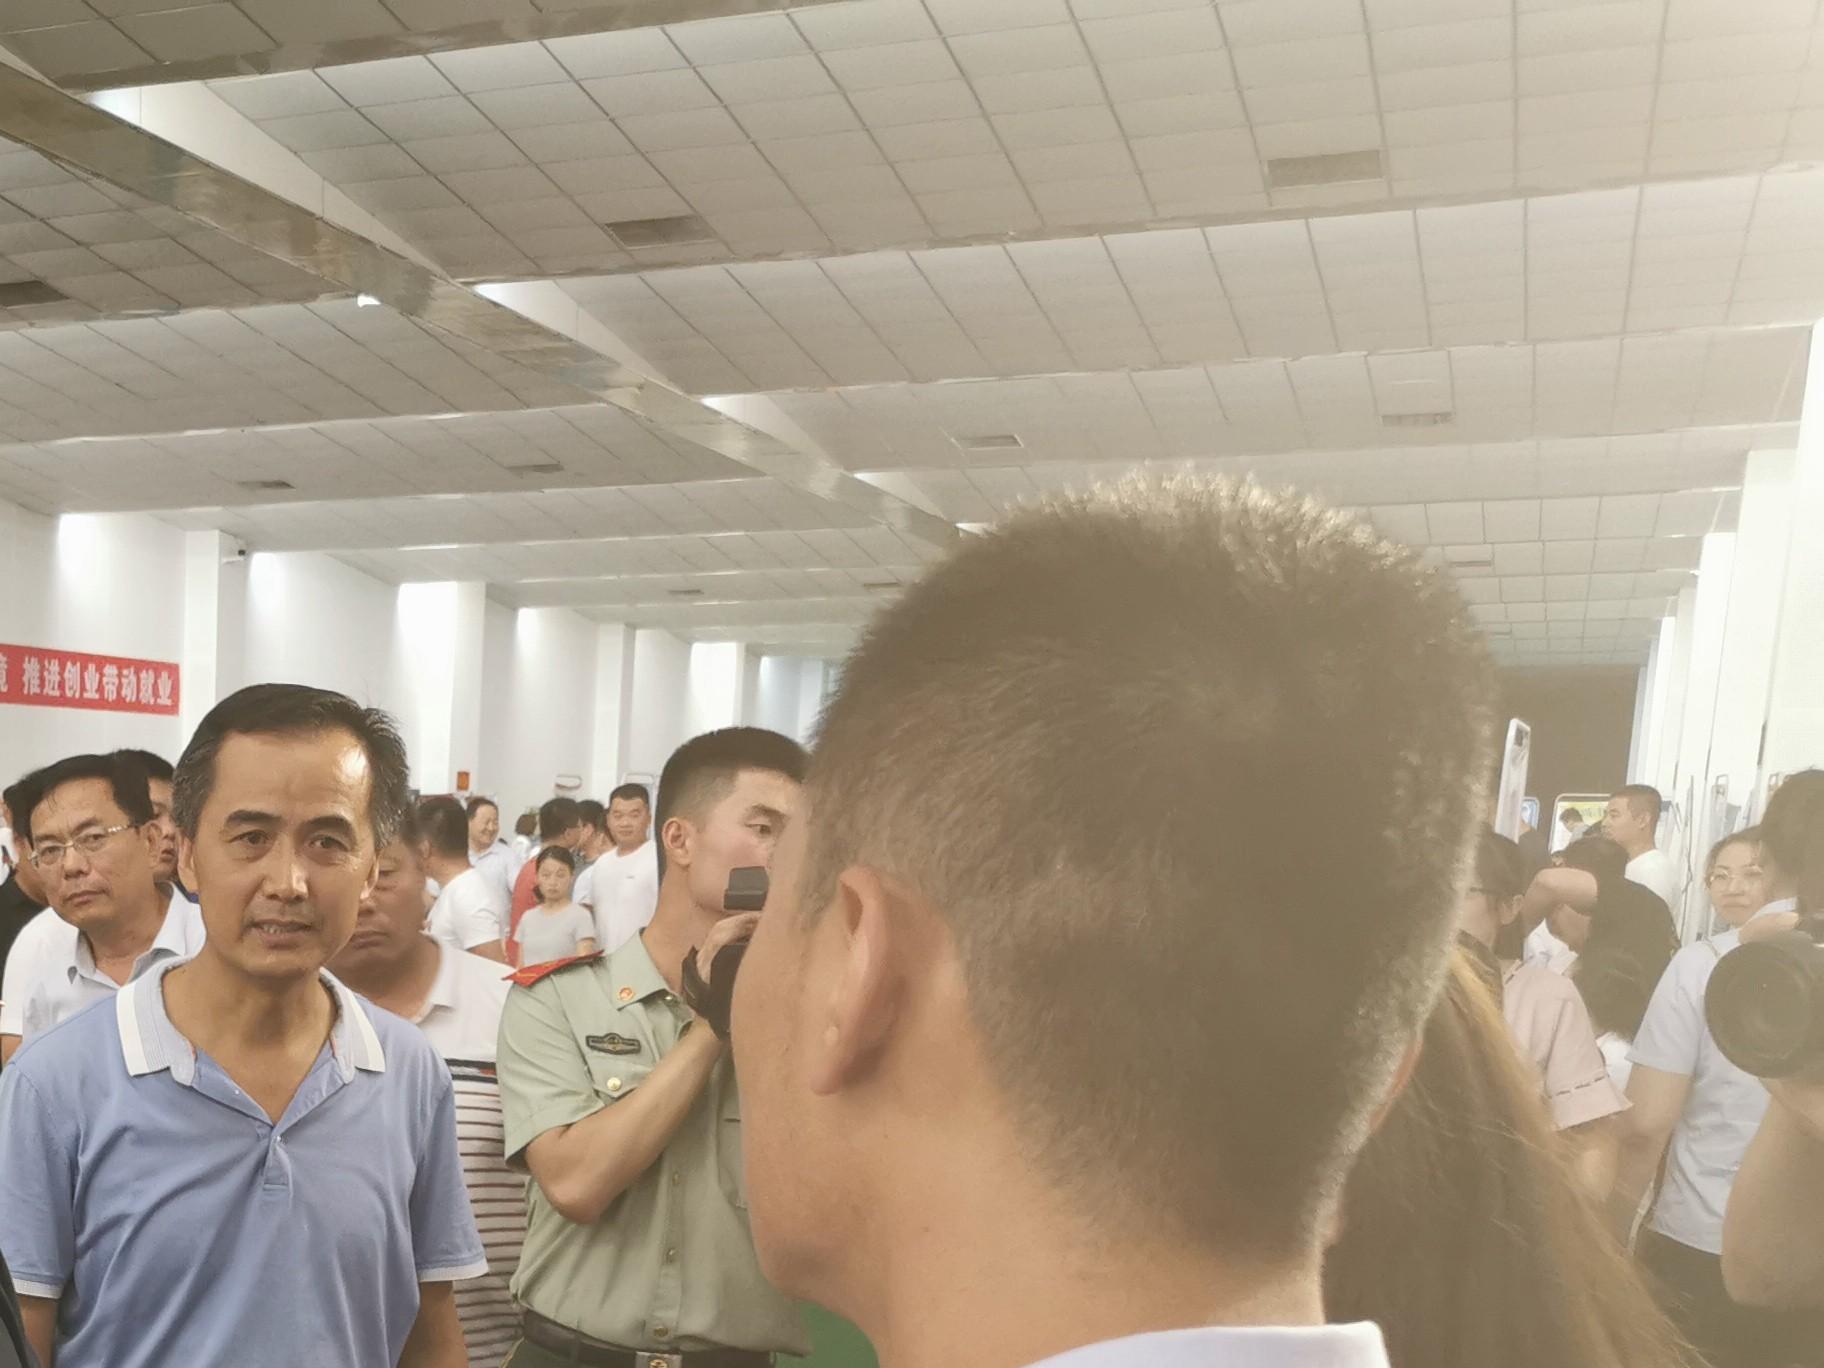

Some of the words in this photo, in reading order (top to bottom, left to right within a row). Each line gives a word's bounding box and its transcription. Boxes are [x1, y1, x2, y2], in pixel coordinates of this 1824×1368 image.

[22, 656, 173, 705] 推进创业带动就业
